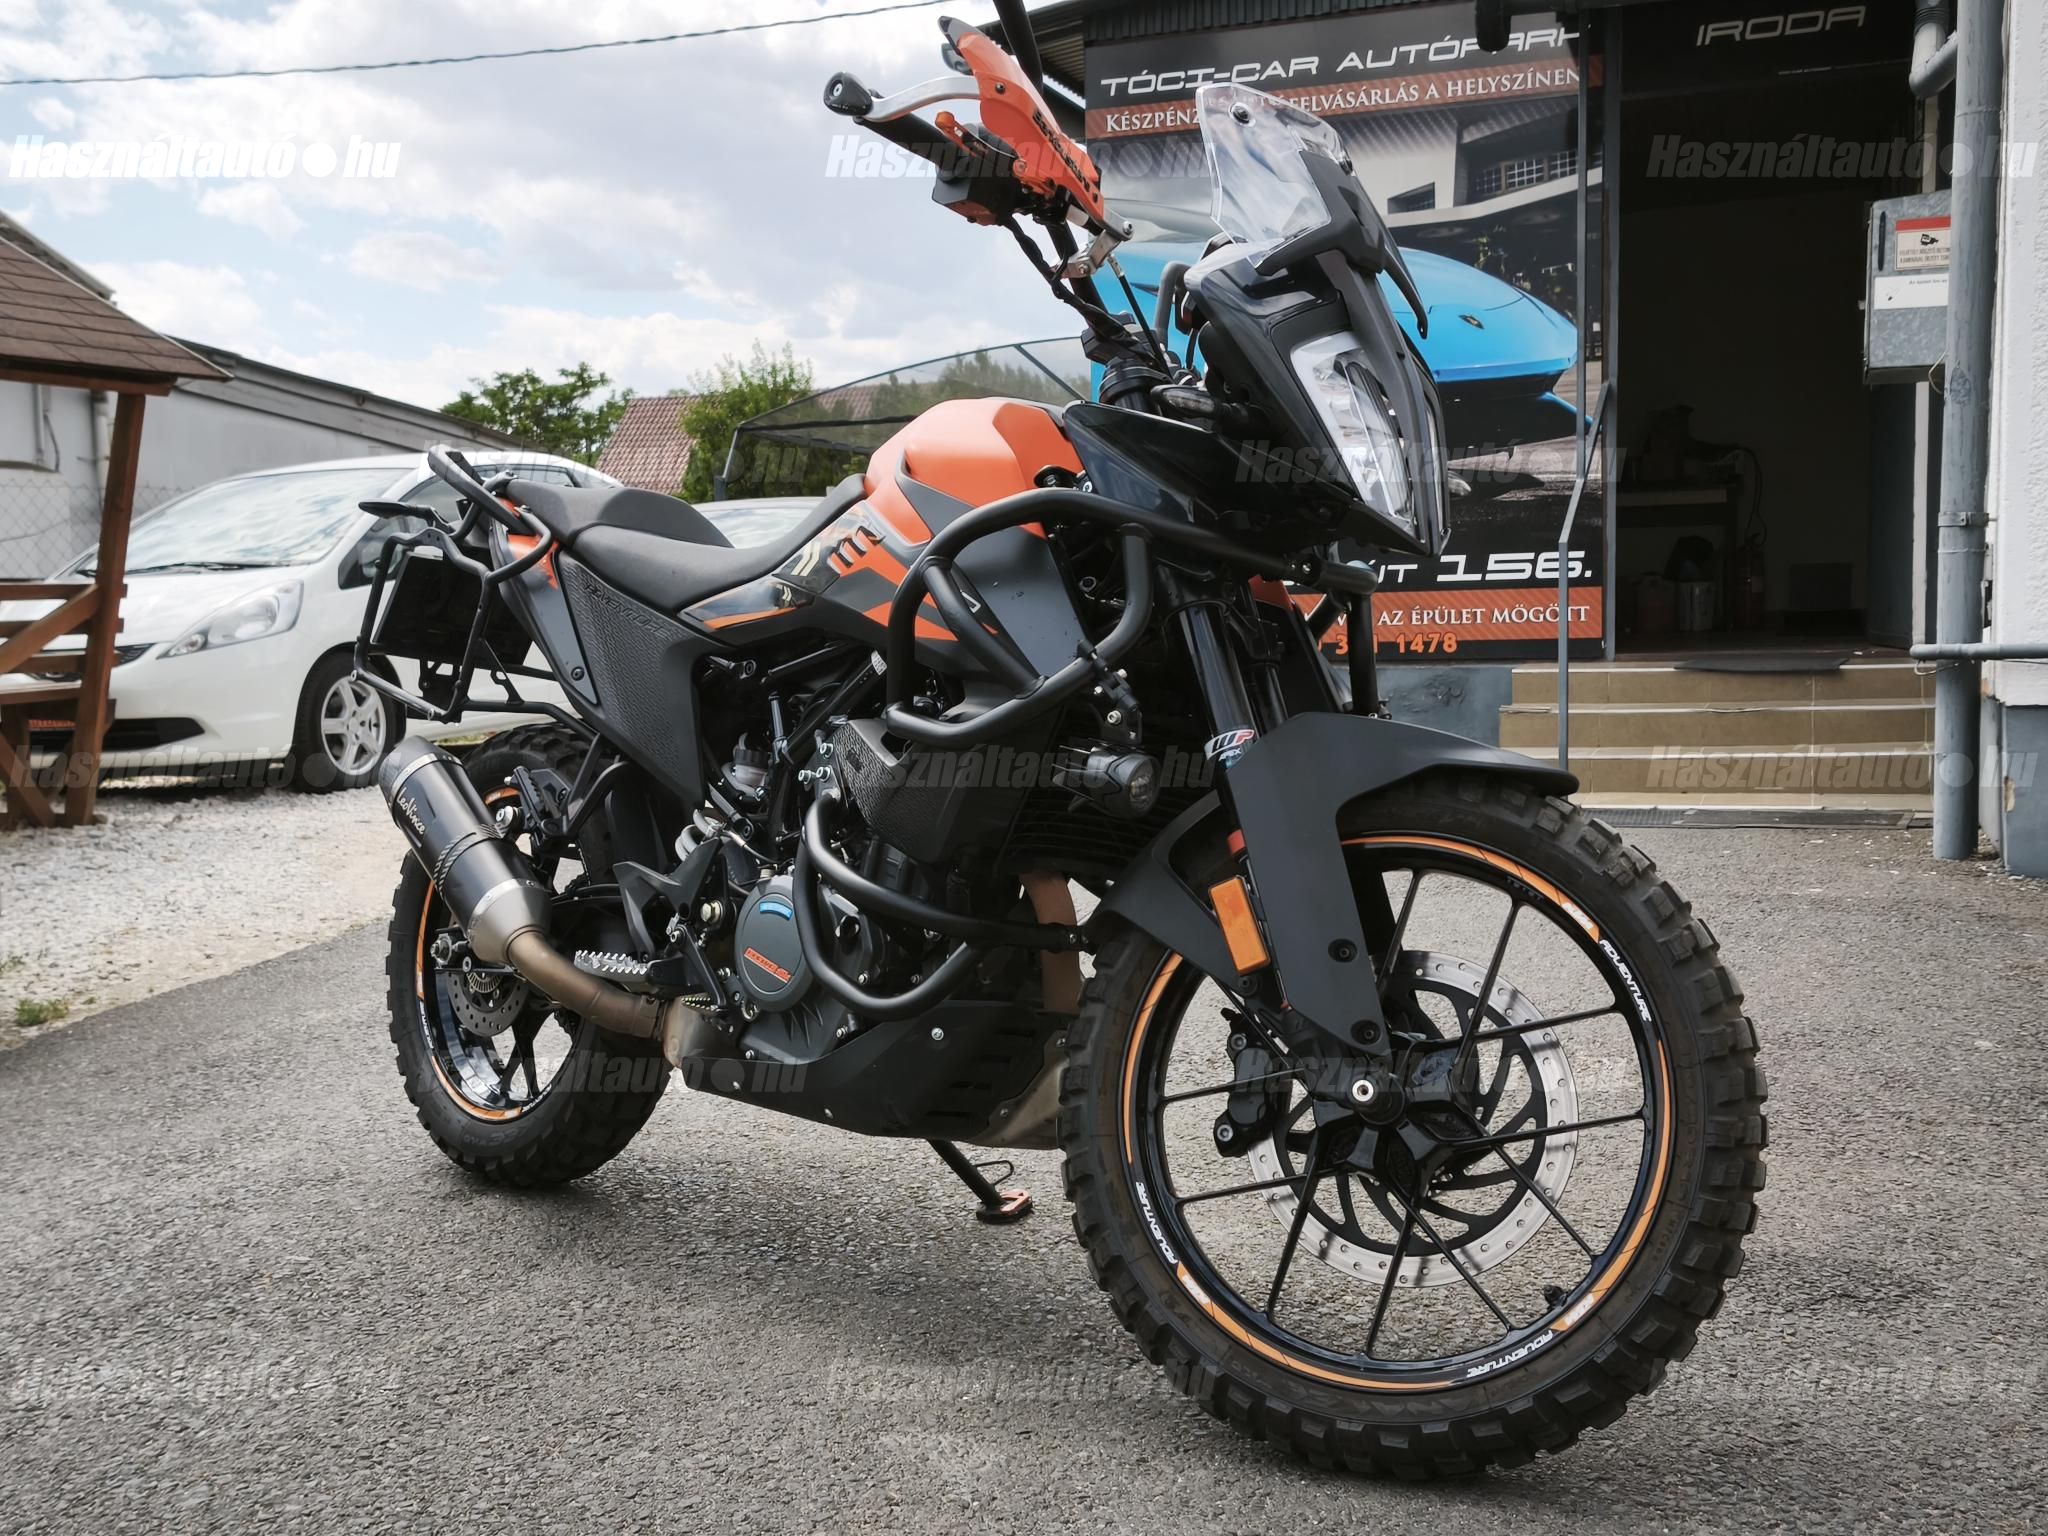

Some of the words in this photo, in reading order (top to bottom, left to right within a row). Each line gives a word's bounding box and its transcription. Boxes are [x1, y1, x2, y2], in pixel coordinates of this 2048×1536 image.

[1696, 5, 1866, 46] IRODA
[1101, 56, 1319, 96] TÓCI-CAR
[1426, 82, 1440, 100] A
[1378, 611, 1404, 627] AZ
[1411, 606, 1486, 626] ÉPÜLET
[1396, 631, 1458, 654] 1478
[396, 788, 426, 836] LeoVince
[1600, 939, 1653, 1023] ADVENTURE
